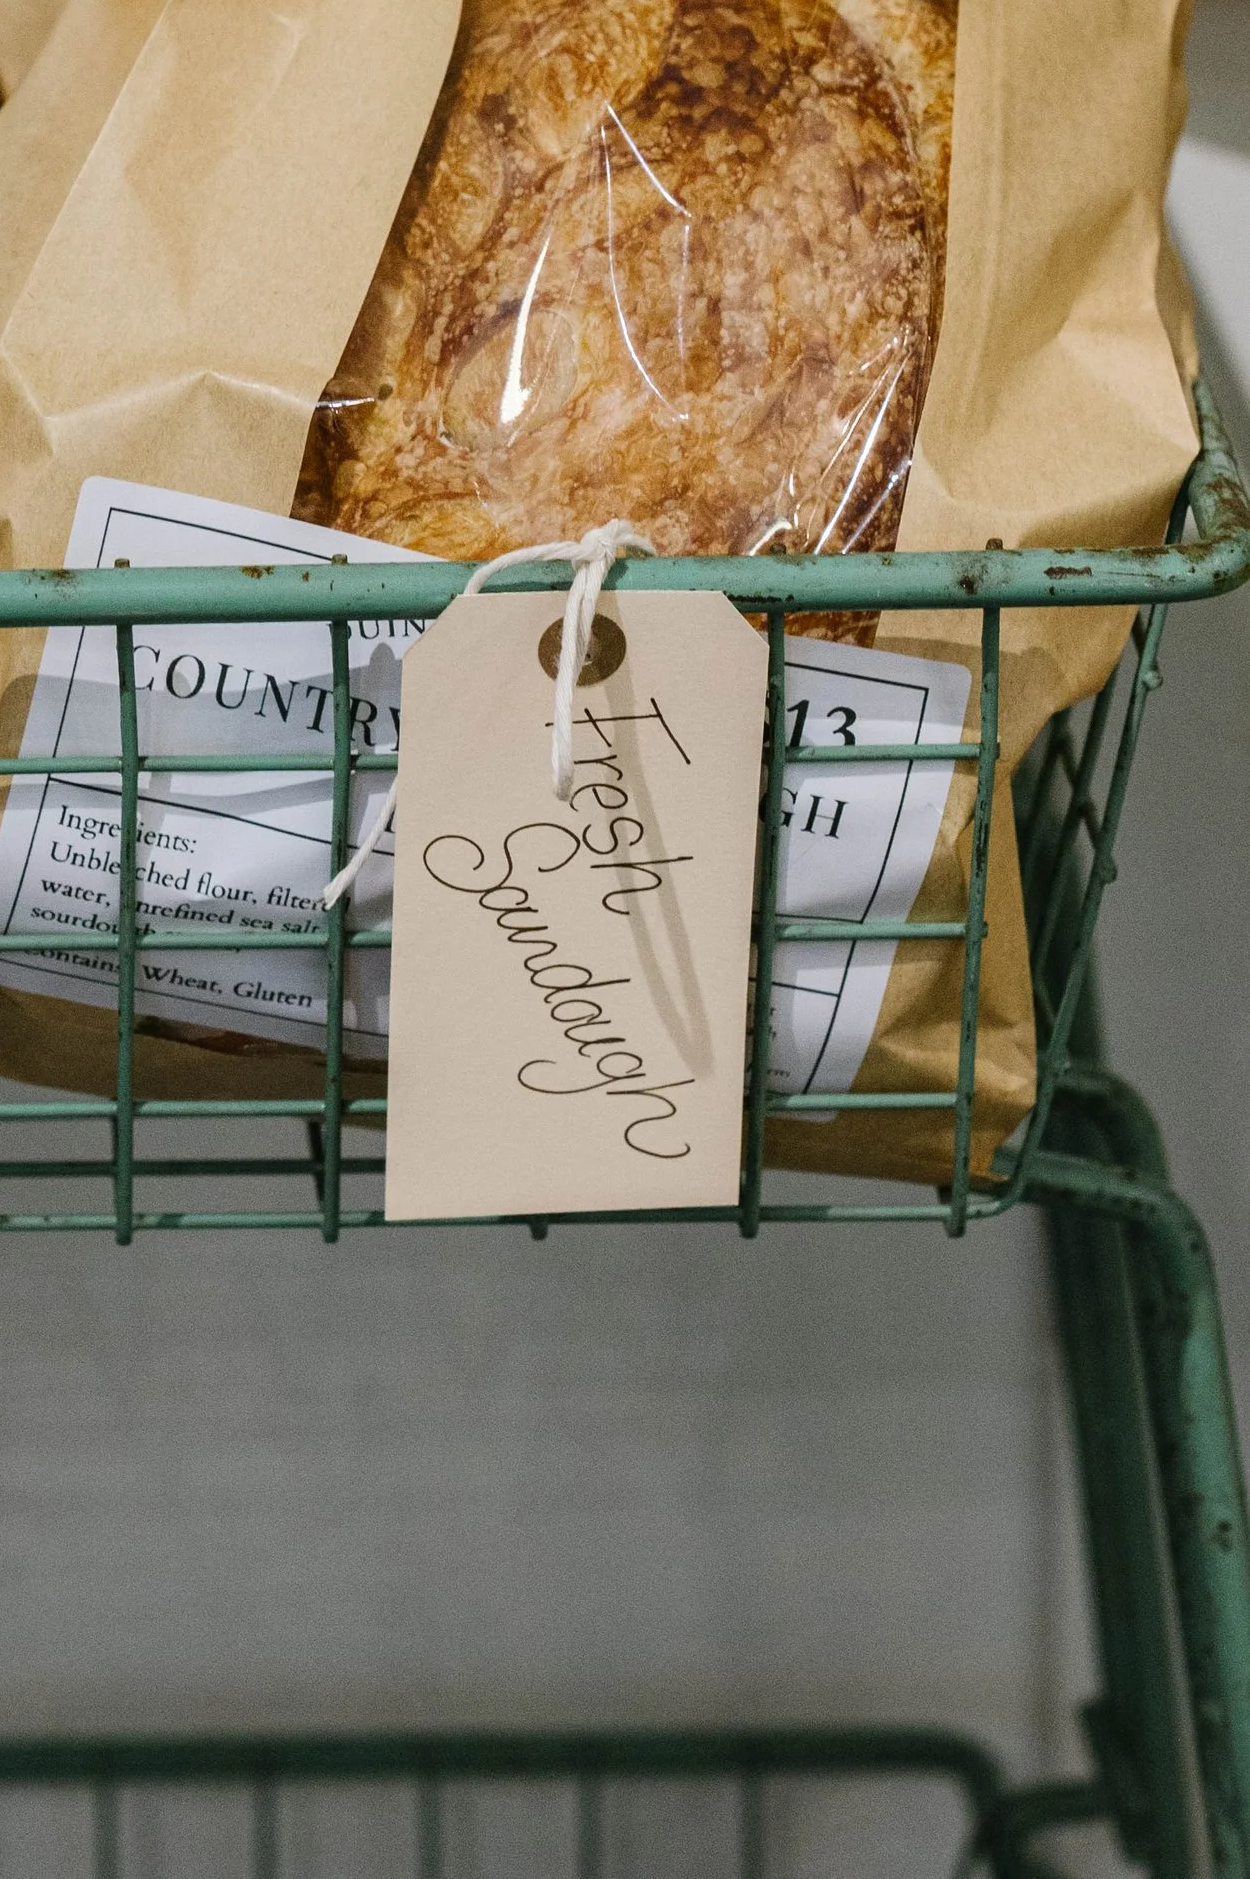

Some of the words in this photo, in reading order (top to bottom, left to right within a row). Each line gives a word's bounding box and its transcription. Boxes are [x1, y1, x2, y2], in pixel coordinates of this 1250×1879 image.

[784, 698, 857, 748] 13
[57, 804, 198, 855] Ingreients:
[545, 696, 694, 916] Fresh
[49, 840, 192, 891] Unbleched
[196, 871, 258, 906] flour,
[266, 885, 351, 914] filtere
[40, 878, 111, 908] water,
[133, 899, 235, 926] nrefined
[239, 916, 275, 931] sea
[141, 963, 224, 994] Wheat,
[232, 980, 314, 1008] Gluten
